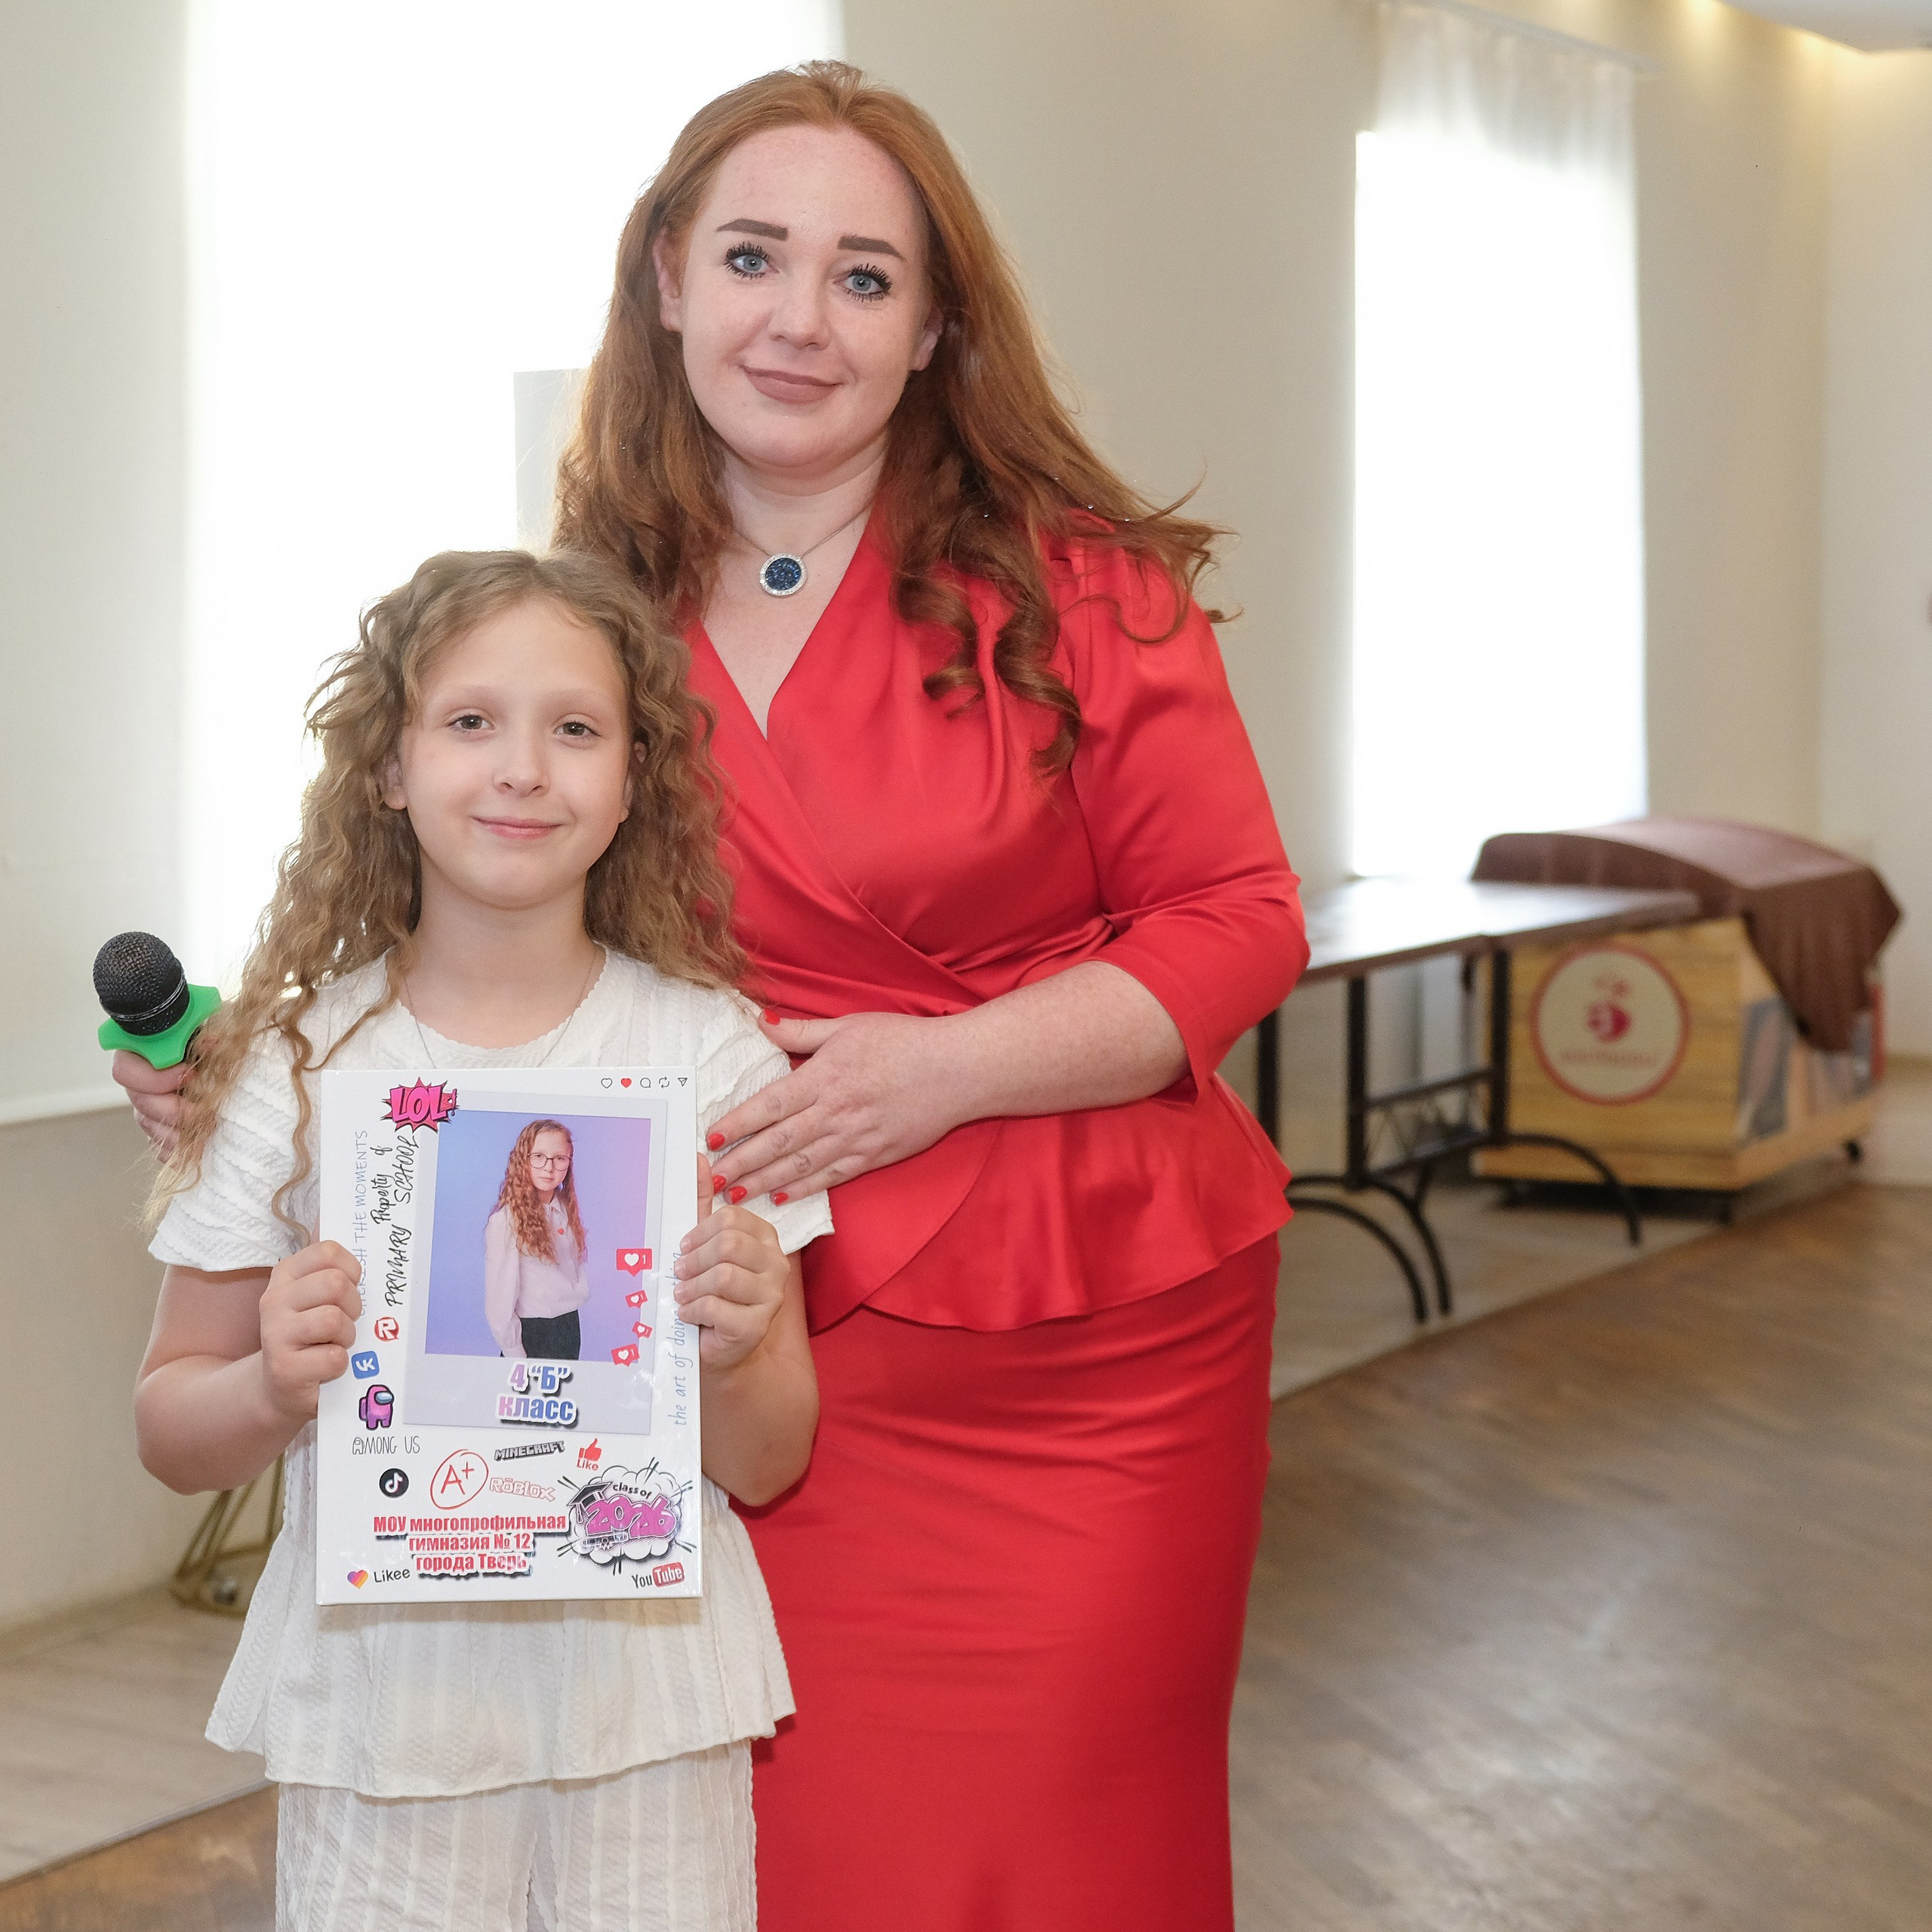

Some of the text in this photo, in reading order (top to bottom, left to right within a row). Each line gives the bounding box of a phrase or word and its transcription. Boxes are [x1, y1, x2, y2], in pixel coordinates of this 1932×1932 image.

[355, 1131, 368, 1207] MOMENTS
[352, 1211, 368, 1244] THE
[384, 1135, 420, 1307] PRIMARY SCHOOL
[669, 1351, 694, 1368] of
[509, 1364, 525, 1389] 4
[673, 1376, 686, 1397] art
[498, 1396, 574, 1422] класс
[667, 1404, 687, 1426] the
[352, 1435, 420, 1455] AMONG US
[494, 1440, 566, 1462] MINECRAFT
[577, 1458, 599, 1471] Like
[440, 1461, 475, 1495] A+
[613, 1482, 652, 1500] class of
[374, 1515, 566, 1533] МОУ многопрофильная
[586, 1494, 677, 1540] 2026
[409, 1535, 490, 1552] гимназия
[514, 1533, 531, 1549] 12
[416, 1555, 475, 1573] города
[374, 1568, 411, 1583] Likee
[632, 1562, 685, 1589] YouTube
